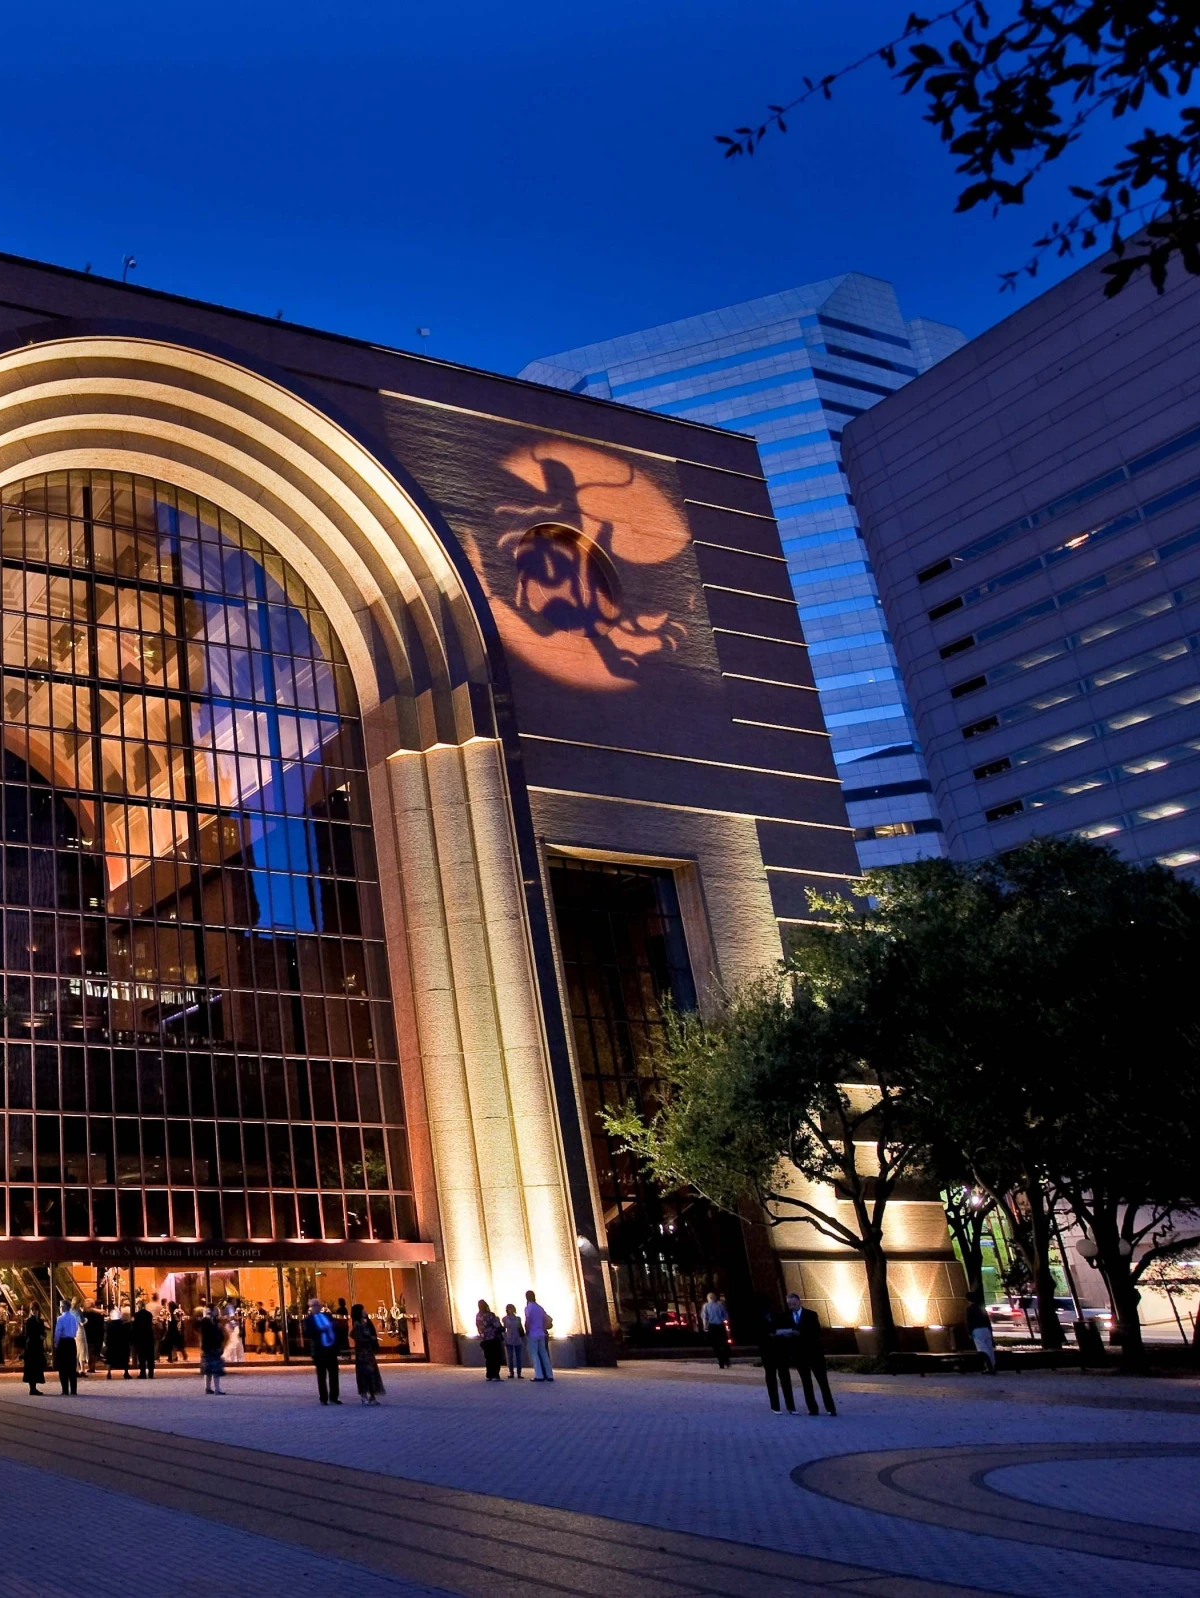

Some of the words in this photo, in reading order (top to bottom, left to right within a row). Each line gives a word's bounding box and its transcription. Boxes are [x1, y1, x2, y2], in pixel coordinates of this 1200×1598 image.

[99, 1245, 121, 1257] Gus
[134, 1245, 182, 1257] Wortham
[185, 1245, 225, 1257] Theater
[228, 1246, 263, 1258] Center
